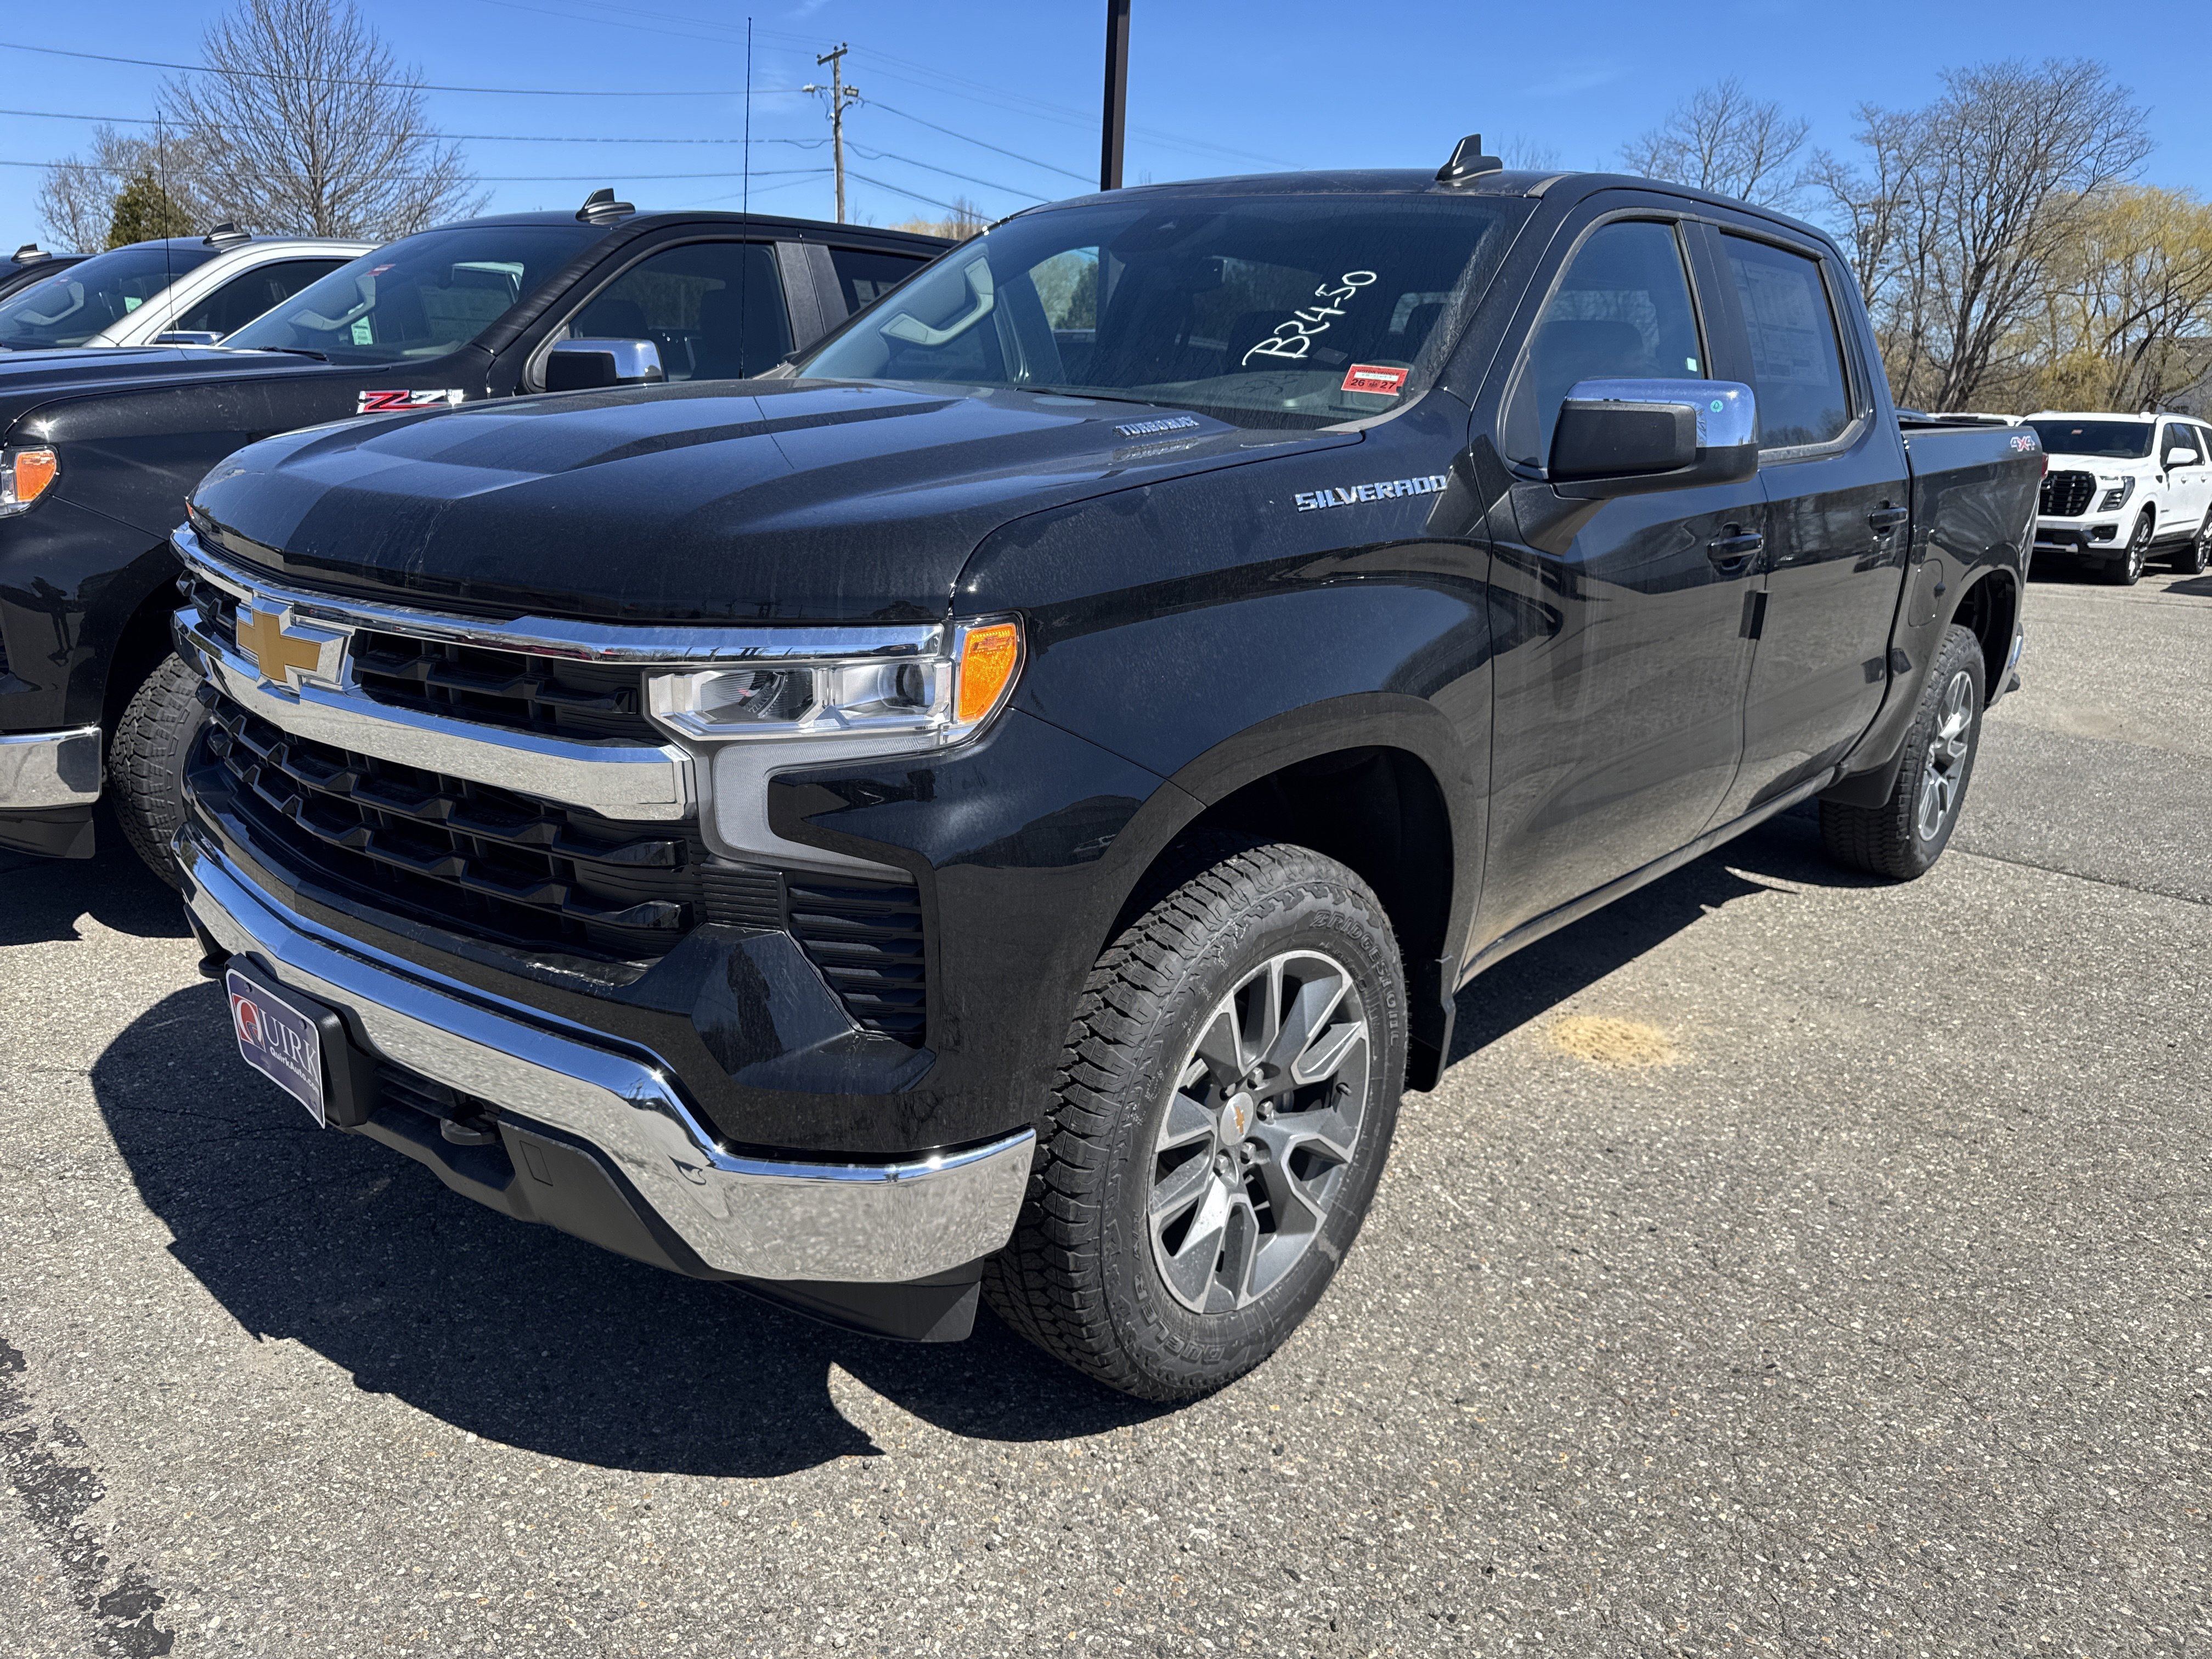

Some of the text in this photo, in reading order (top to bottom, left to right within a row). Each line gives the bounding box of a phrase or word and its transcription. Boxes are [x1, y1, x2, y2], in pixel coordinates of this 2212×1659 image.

[357, 389, 464, 414] Z71
[1350, 378, 1397, 390] 26 27
[1295, 475, 1448, 512] SILVERADO
[1310, 909, 1400, 1047] BRIDGESTONE
[236, 998, 320, 1085] QUIRK
[269, 1046, 320, 1096] QuirkAuto.com
